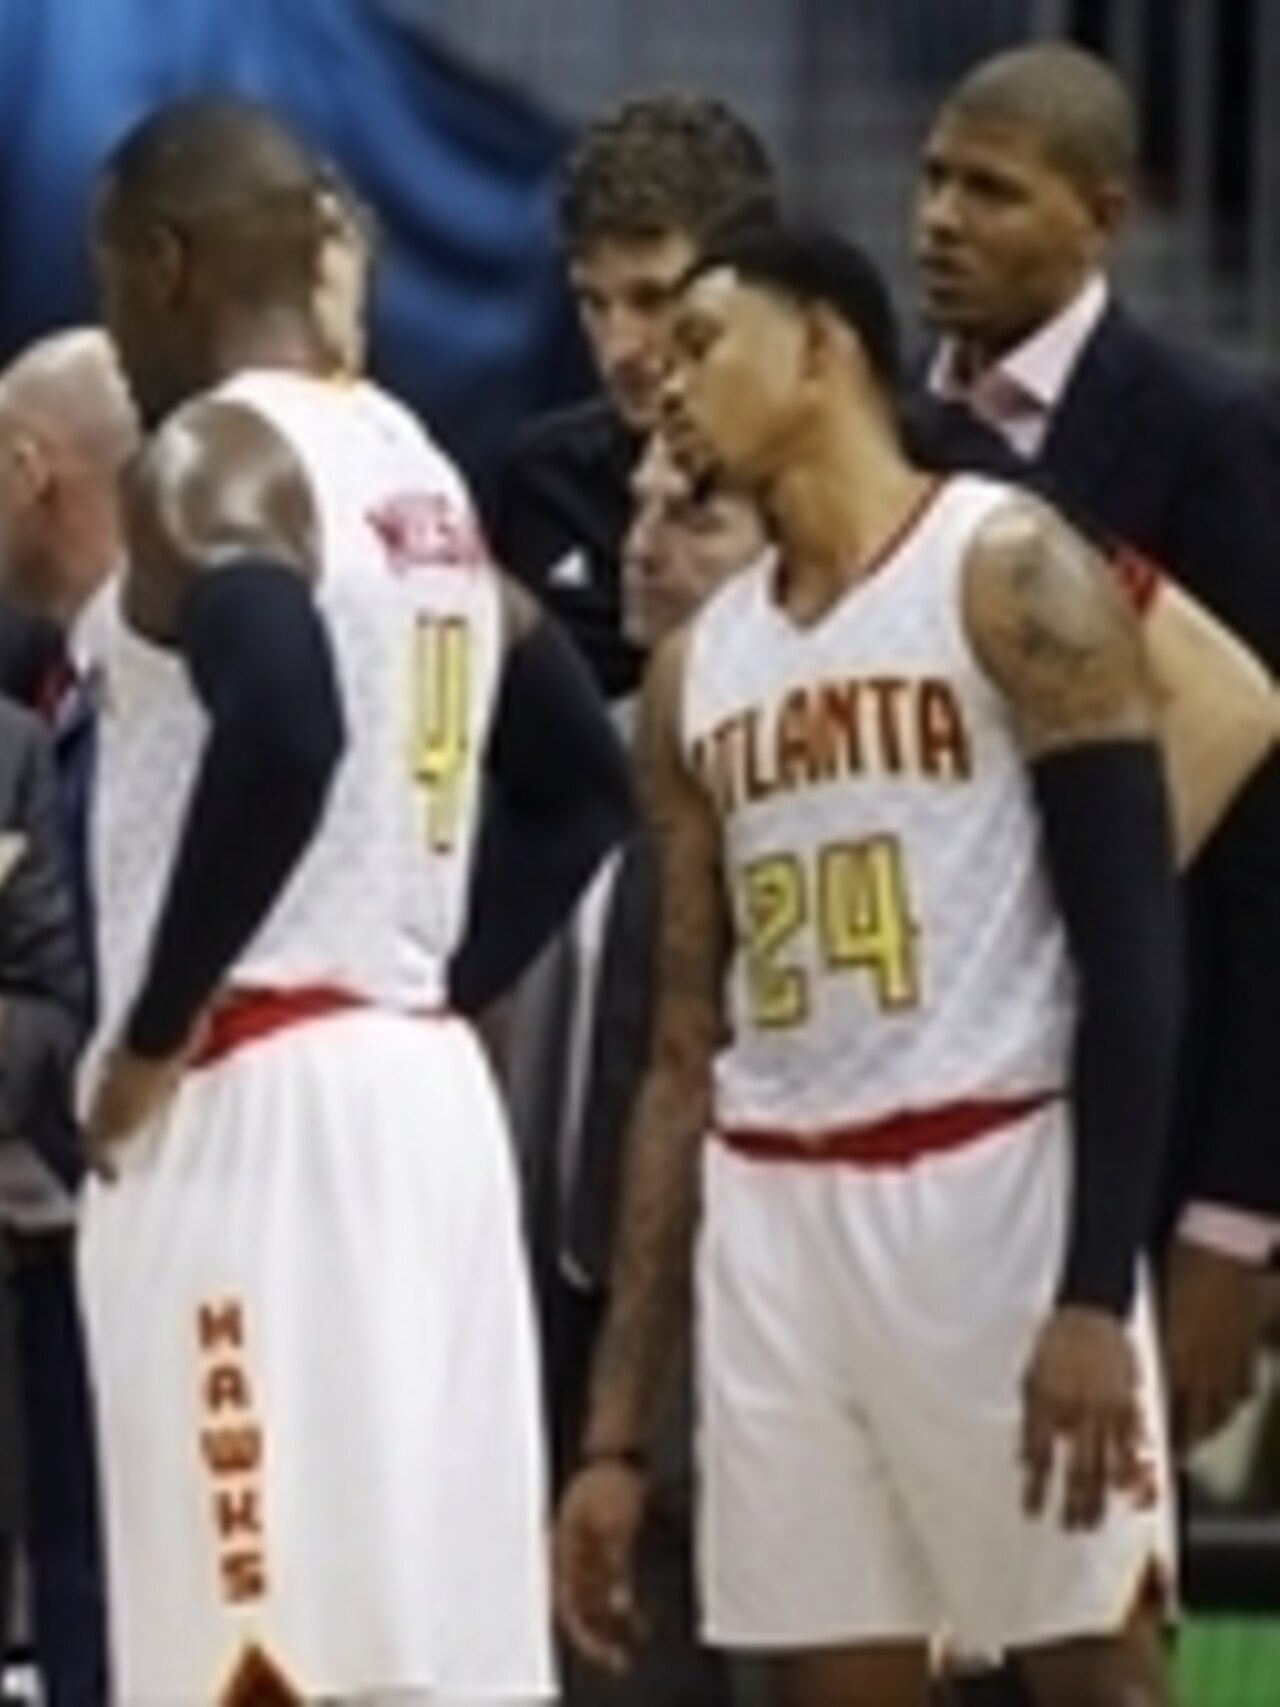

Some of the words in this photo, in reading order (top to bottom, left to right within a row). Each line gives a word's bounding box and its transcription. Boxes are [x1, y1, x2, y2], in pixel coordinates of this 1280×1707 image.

[413, 610, 473, 856] 4
[690, 675, 973, 810] TLANTA
[743, 834, 922, 1030] 24
[197, 1300, 266, 1606] HAWKS
